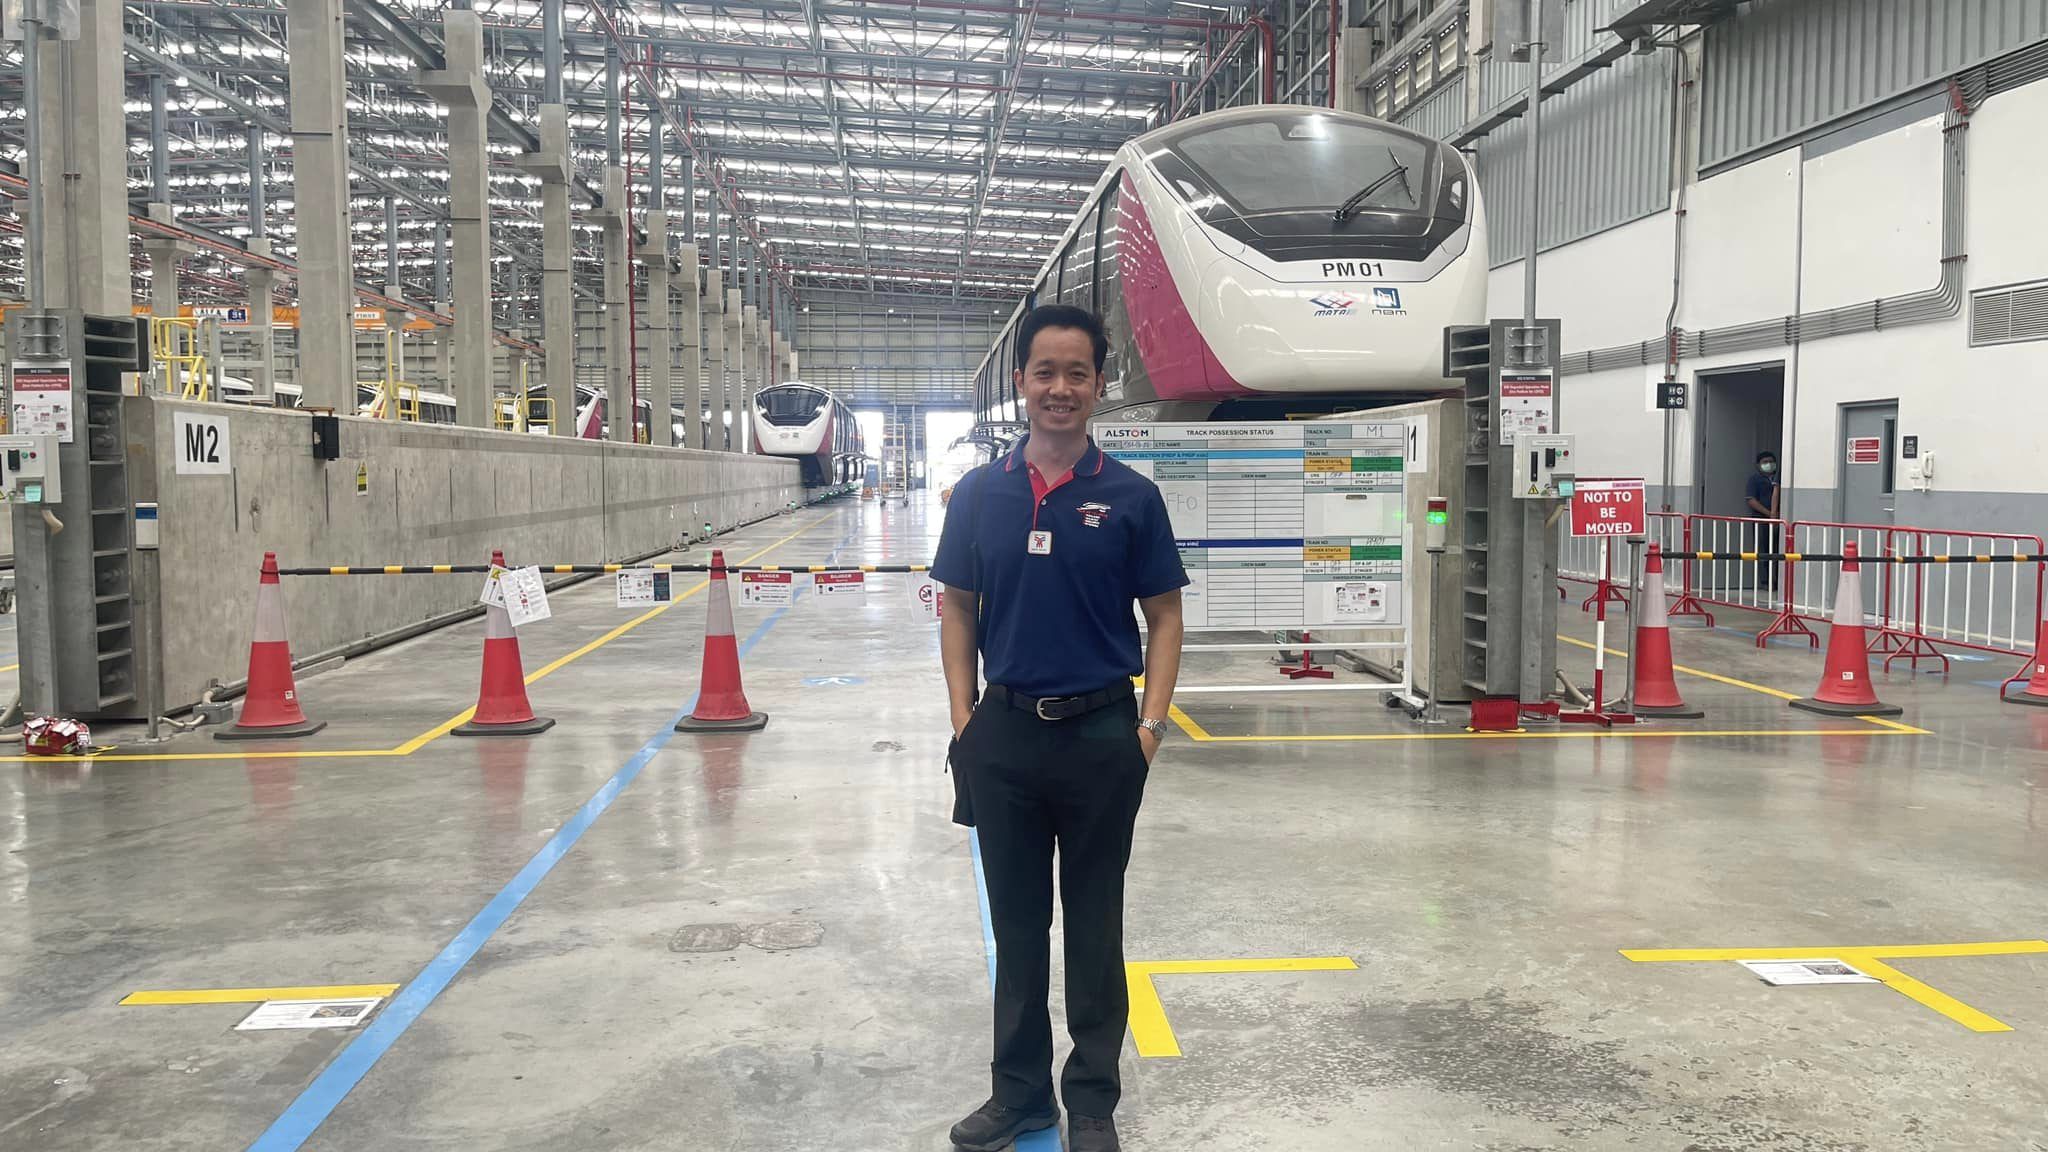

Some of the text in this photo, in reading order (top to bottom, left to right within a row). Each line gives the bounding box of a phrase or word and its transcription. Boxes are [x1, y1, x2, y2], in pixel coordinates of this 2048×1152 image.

[1322, 262, 1384, 277] PM 01
[1105, 429, 1149, 438] ALSTOM
[185, 423, 220, 463] M2
[1583, 491, 1632, 503] NOT TO
[1600, 507, 1617, 518] BE
[1585, 522, 1632, 534] MOVED
